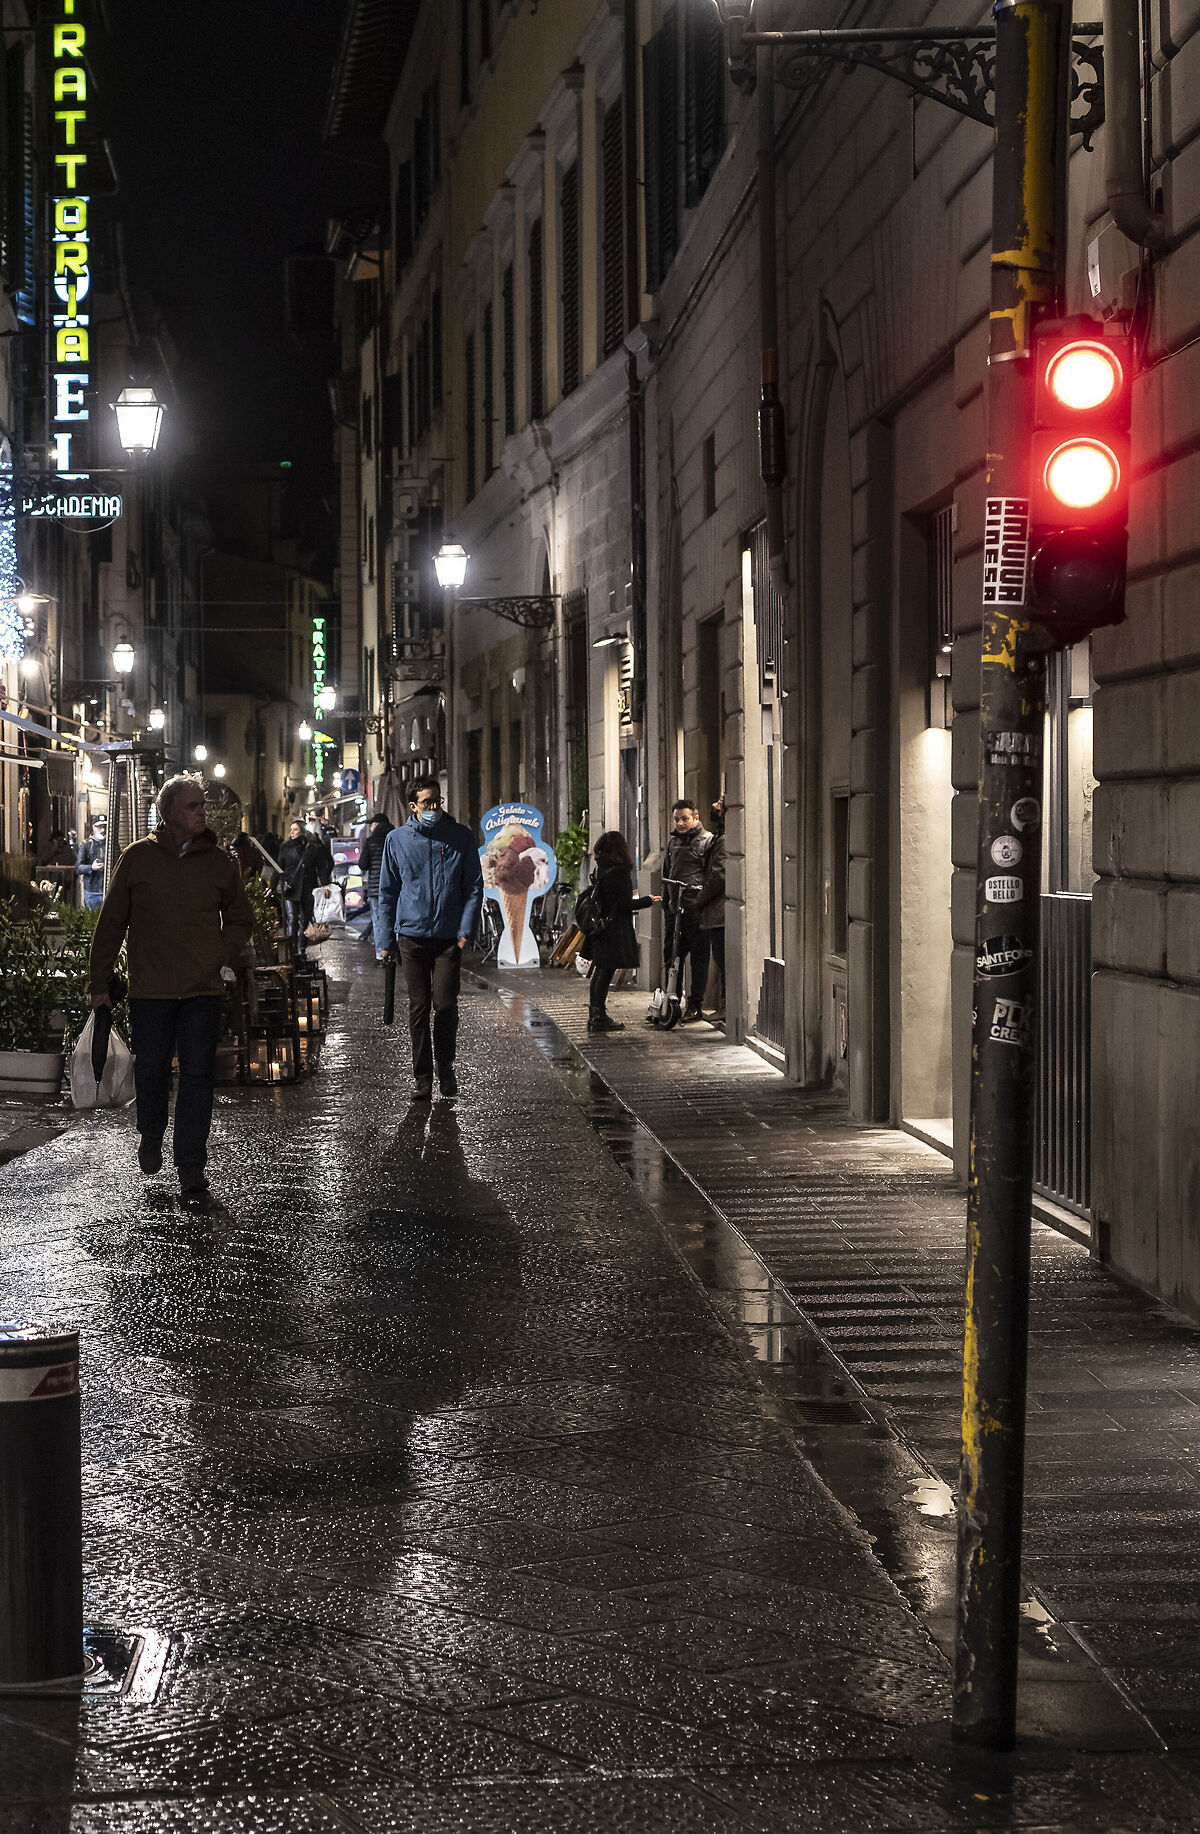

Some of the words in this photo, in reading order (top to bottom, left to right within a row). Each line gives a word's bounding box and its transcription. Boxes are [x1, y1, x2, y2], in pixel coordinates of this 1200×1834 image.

[498, 805, 526, 817] Gelato
[485, 814, 540, 831] Artigianale
[988, 878, 1020, 890] OSTELLO
[992, 889, 1017, 901] BELLO
[976, 951, 1004, 968] SAINT
